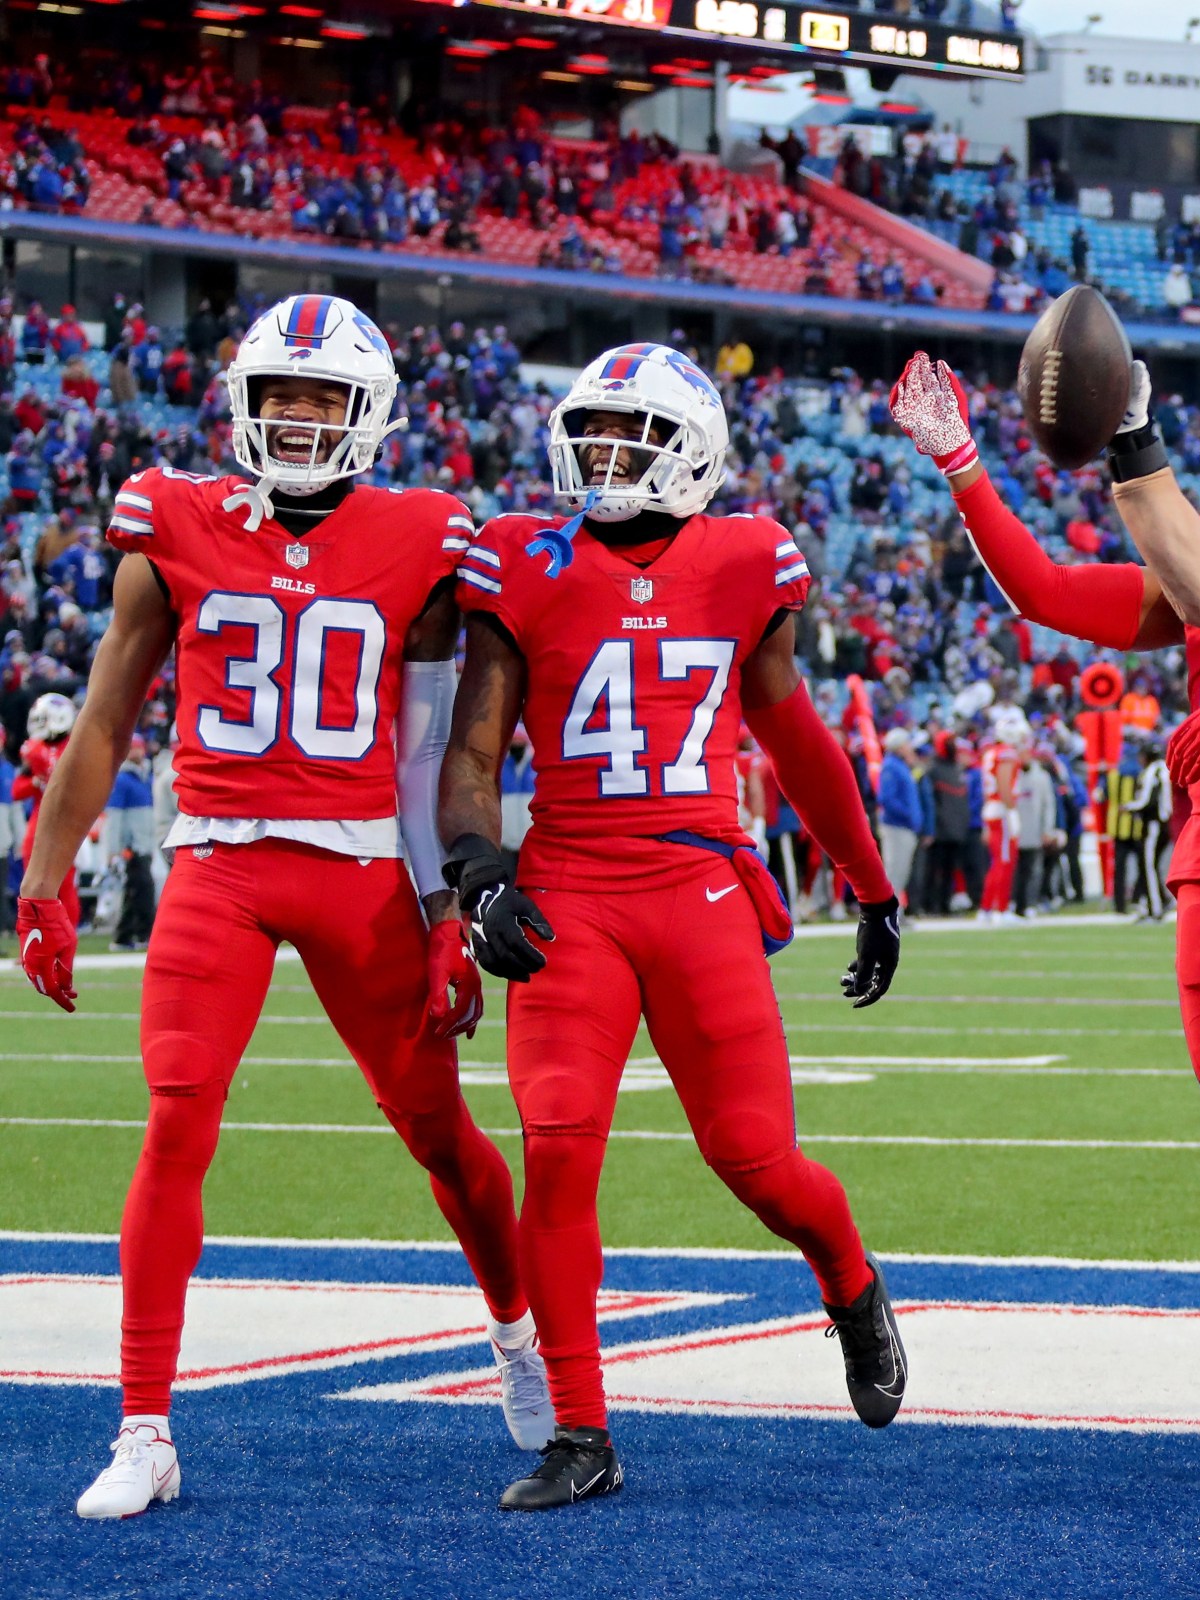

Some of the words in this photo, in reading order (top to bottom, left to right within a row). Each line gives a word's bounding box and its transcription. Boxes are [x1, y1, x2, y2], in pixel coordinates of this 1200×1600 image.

[271, 576, 316, 594] BILLS
[621, 616, 668, 629] BILLS
[196, 589, 386, 762] 30
[560, 638, 739, 798] 47
